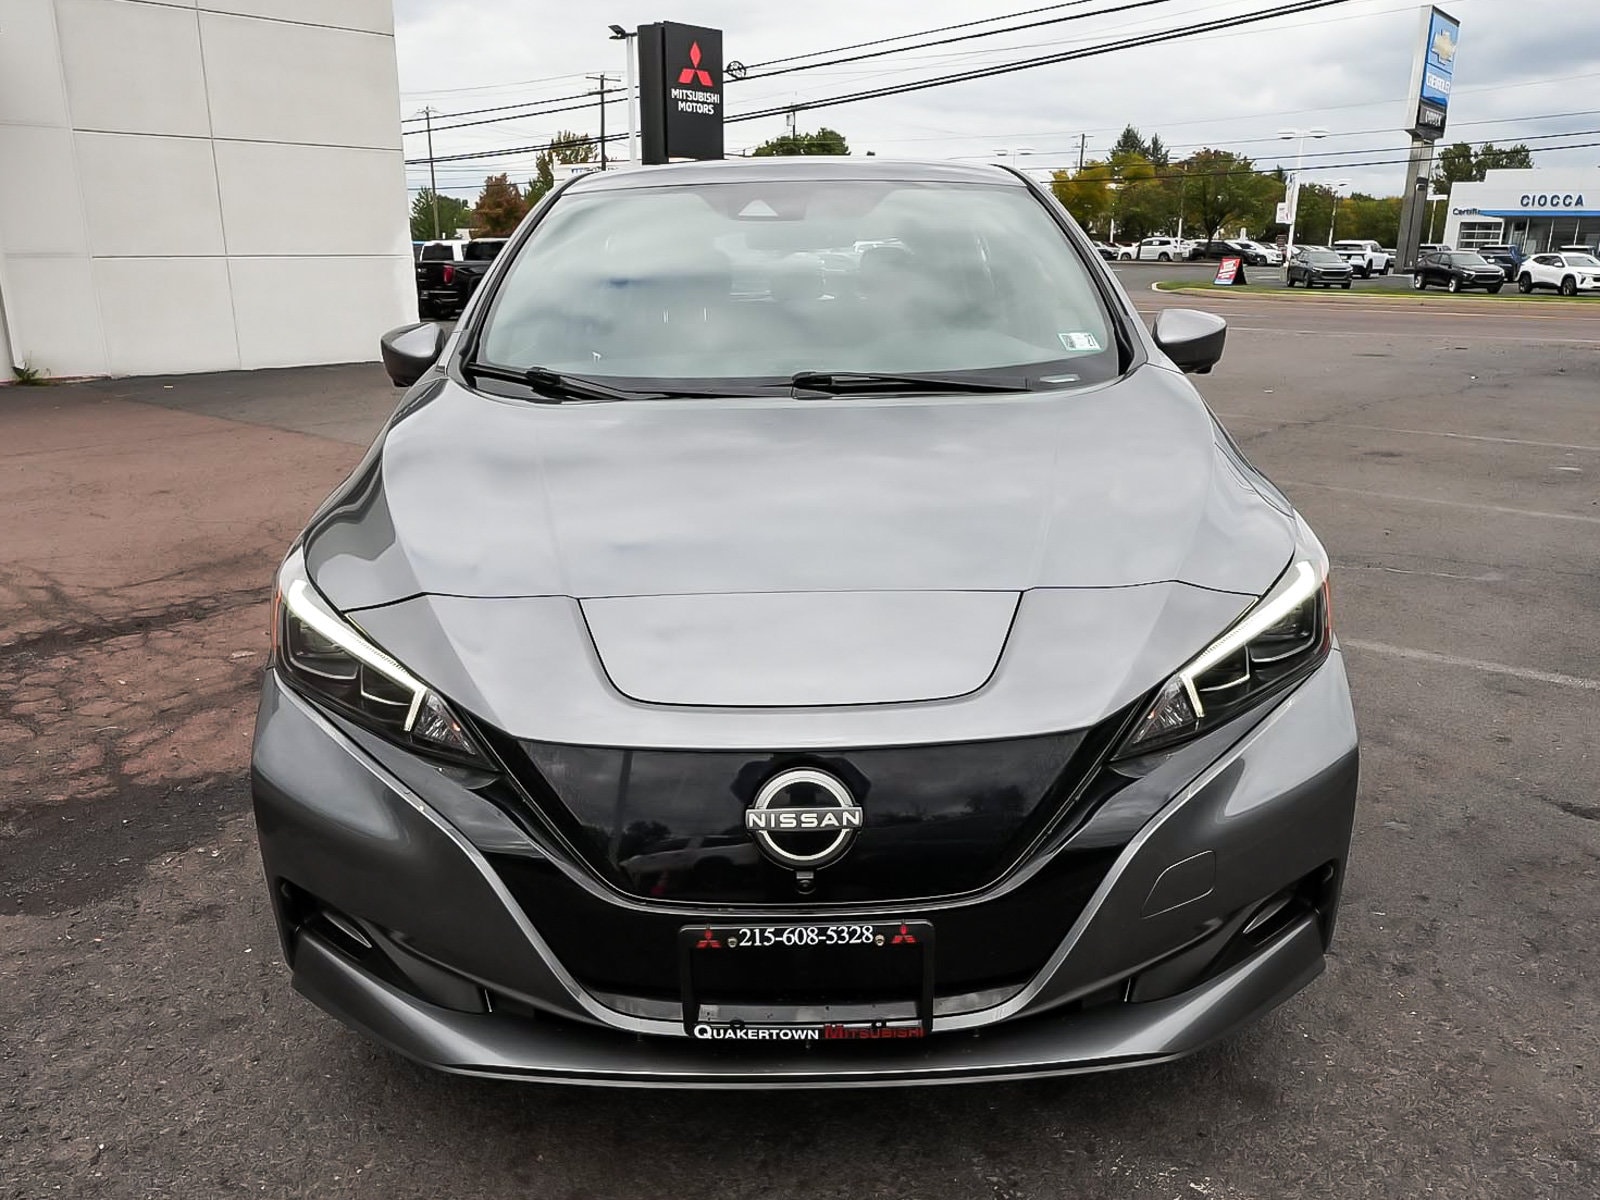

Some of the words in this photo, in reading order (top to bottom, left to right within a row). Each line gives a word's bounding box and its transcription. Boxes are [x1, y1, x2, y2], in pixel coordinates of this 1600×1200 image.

[671, 88, 720, 104] MITSUBISHI
[678, 101, 714, 115] MOTORS
[1520, 194, 1584, 207] CIOCCA
[748, 811, 860, 828] NISSAN
[739, 925, 874, 947] 215-608-5328
[693, 1024, 819, 1040] QUAKERTOWN
[824, 1023, 924, 1039] MITSUBISHI
